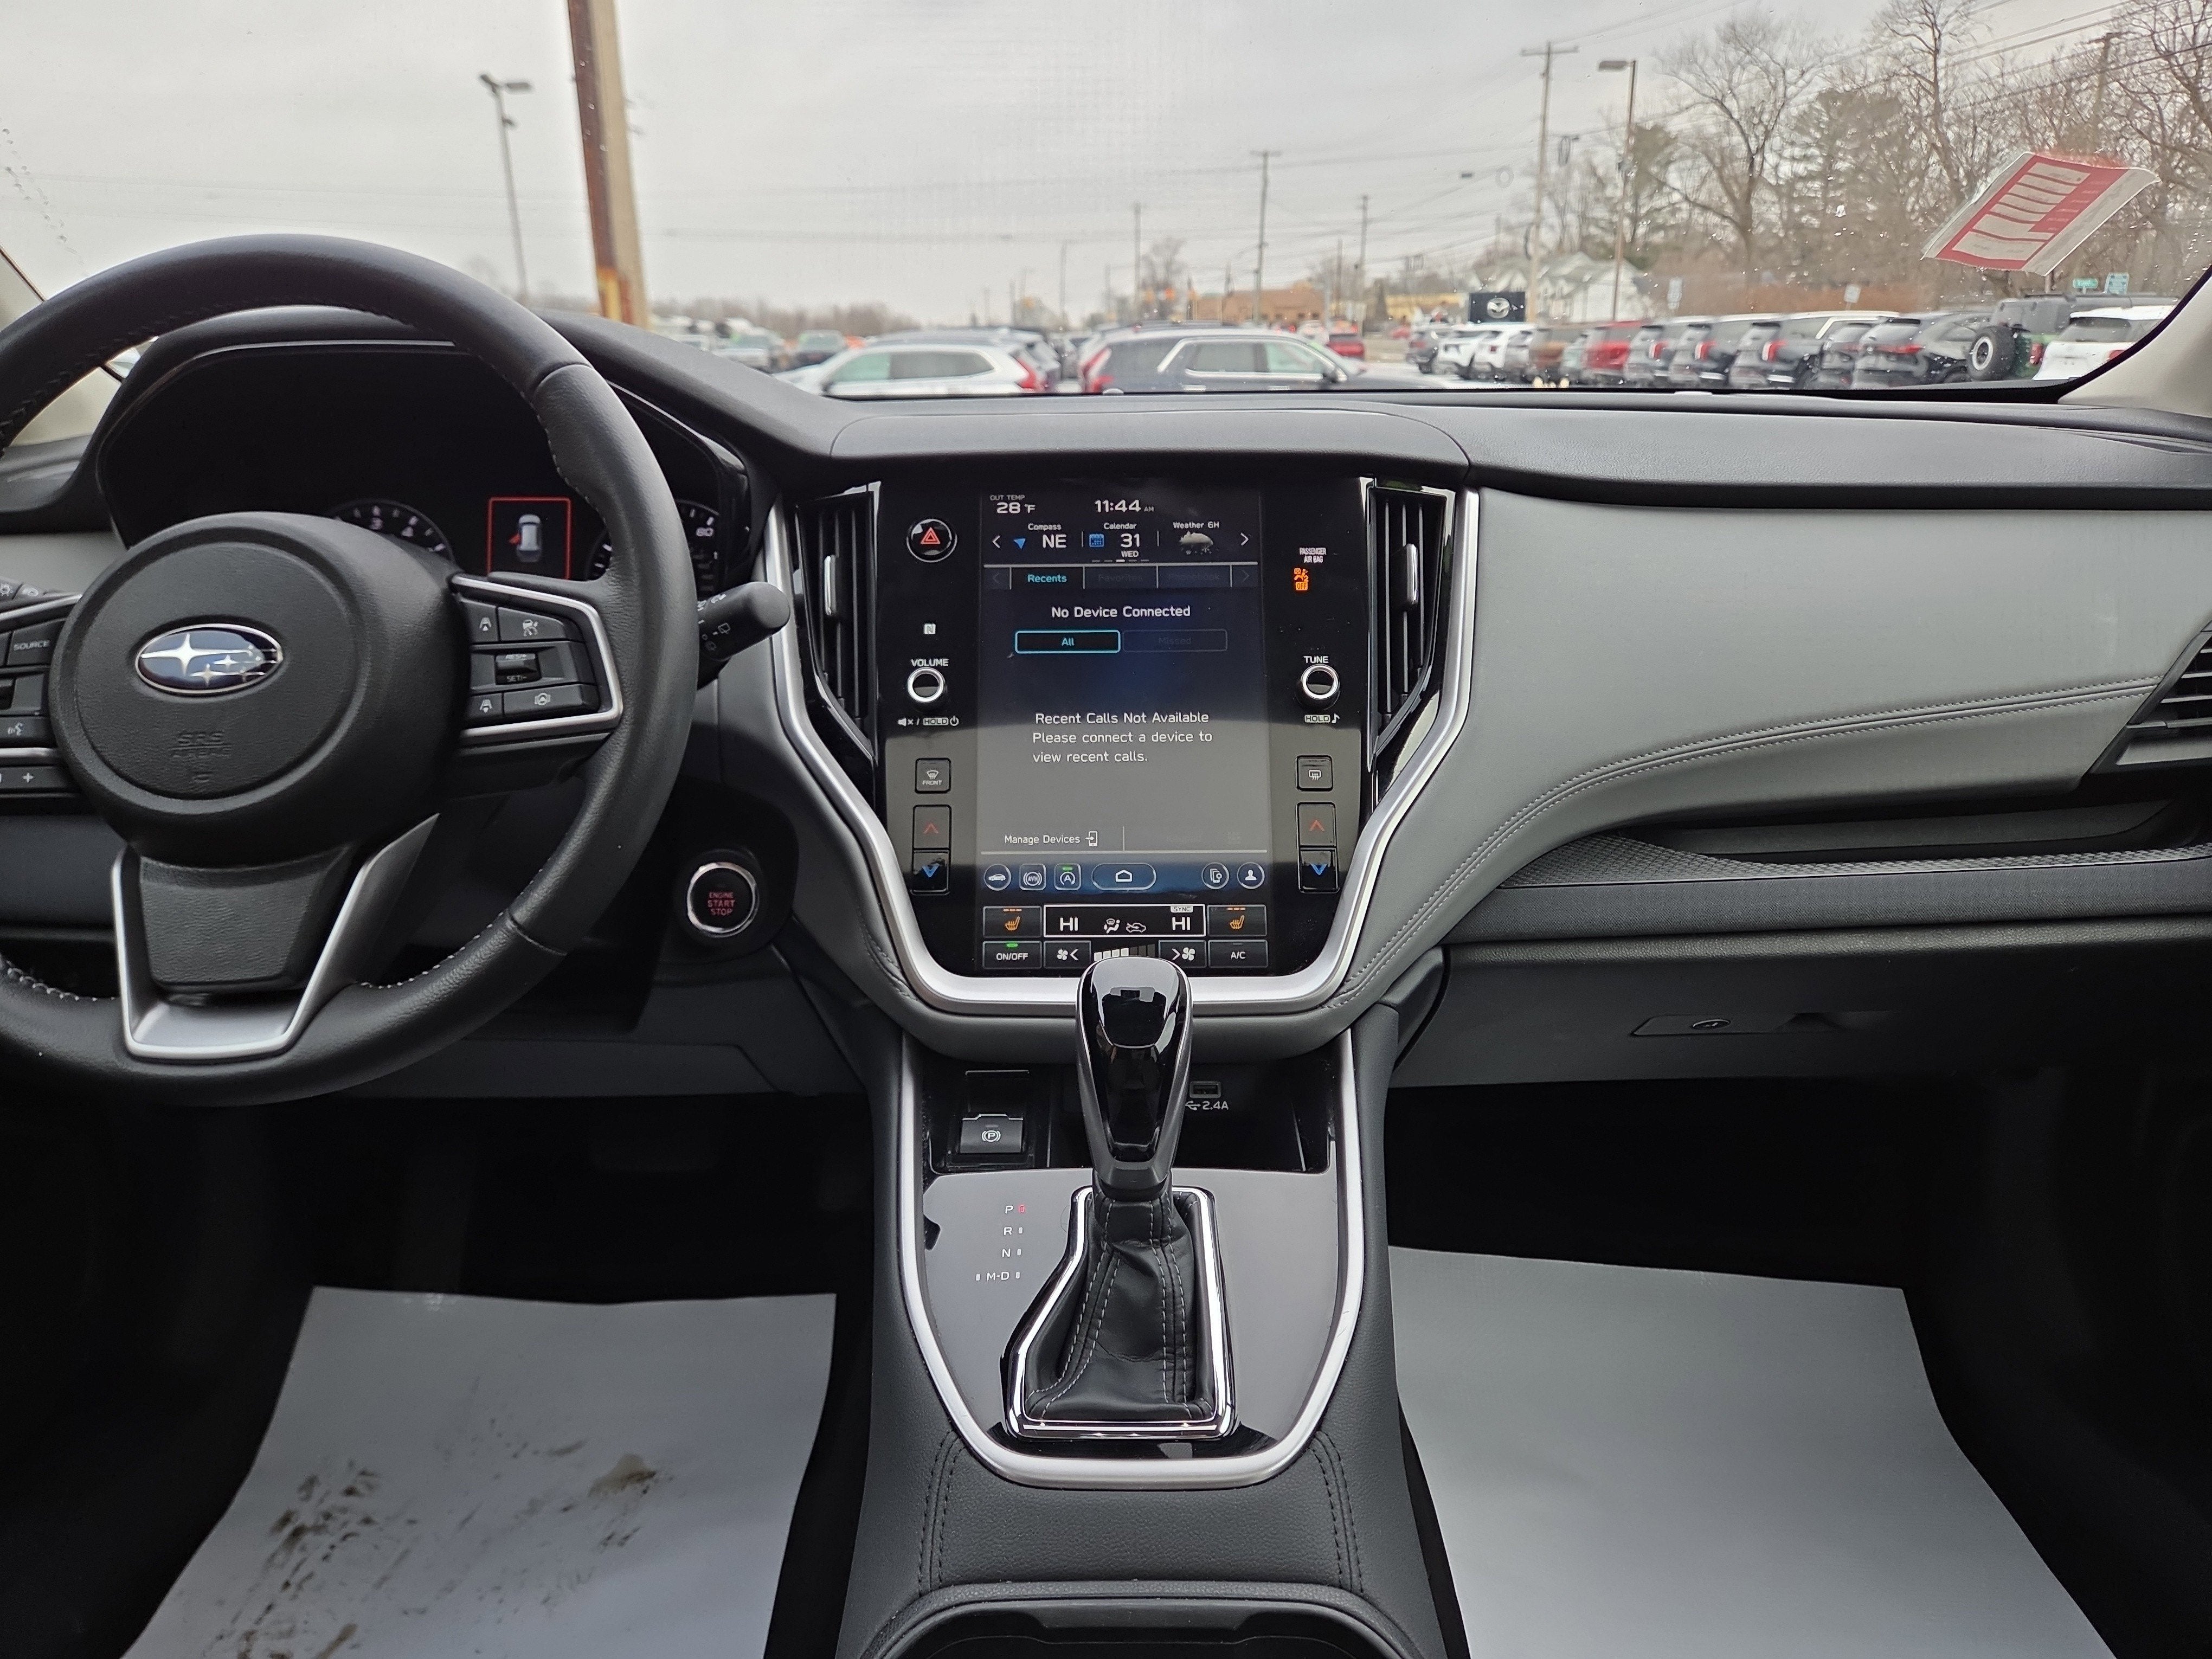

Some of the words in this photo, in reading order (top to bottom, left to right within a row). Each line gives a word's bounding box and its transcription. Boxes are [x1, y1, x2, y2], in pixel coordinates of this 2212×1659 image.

[996, 501, 1021, 514] 28
[1095, 499, 1141, 512] 11:44
[1027, 523, 1062, 531] Compass
[1043, 534, 1067, 548] NE
[1120, 533, 1140, 548] 31
[1027, 574, 1067, 583] Recents
[1051, 607, 1069, 618] No
[1074, 606, 1118, 618] Device
[1123, 605, 1191, 618] Connected
[14, 640, 50, 651] SOURCE
[1061, 638, 1075, 646] All
[911, 658, 949, 667] VOLUME
[1303, 655, 1329, 664] TUNE
[1036, 713, 1081, 724] Recent
[1086, 712, 1118, 724] Calls
[1123, 712, 1147, 724] Not
[1152, 712, 1209, 723] Available
[1033, 732, 1077, 743] Please
[1082, 732, 1133, 743] connect
[1139, 734, 1146, 742] a
[1151, 731, 1193, 742] device
[1199, 731, 1212, 742] to
[1032, 751, 1062, 762] view
[1066, 751, 1109, 762] recent
[1114, 751, 1148, 762] calls.
[1004, 835, 1039, 846] Manage
[1043, 834, 1081, 844] Devices
[707, 899, 736, 908] START
[710, 908, 733, 916] STOP
[1059, 917, 1078, 931] HI
[1172, 916, 1191, 930] HI
[996, 953, 1028, 961] ON/OFF
[1230, 951, 1246, 959] A/C
[1202, 1100, 1229, 1110] 2.4A
[1005, 1205, 1013, 1214] P
[1004, 1226, 1012, 1236] R
[1001, 1248, 1011, 1258] N
